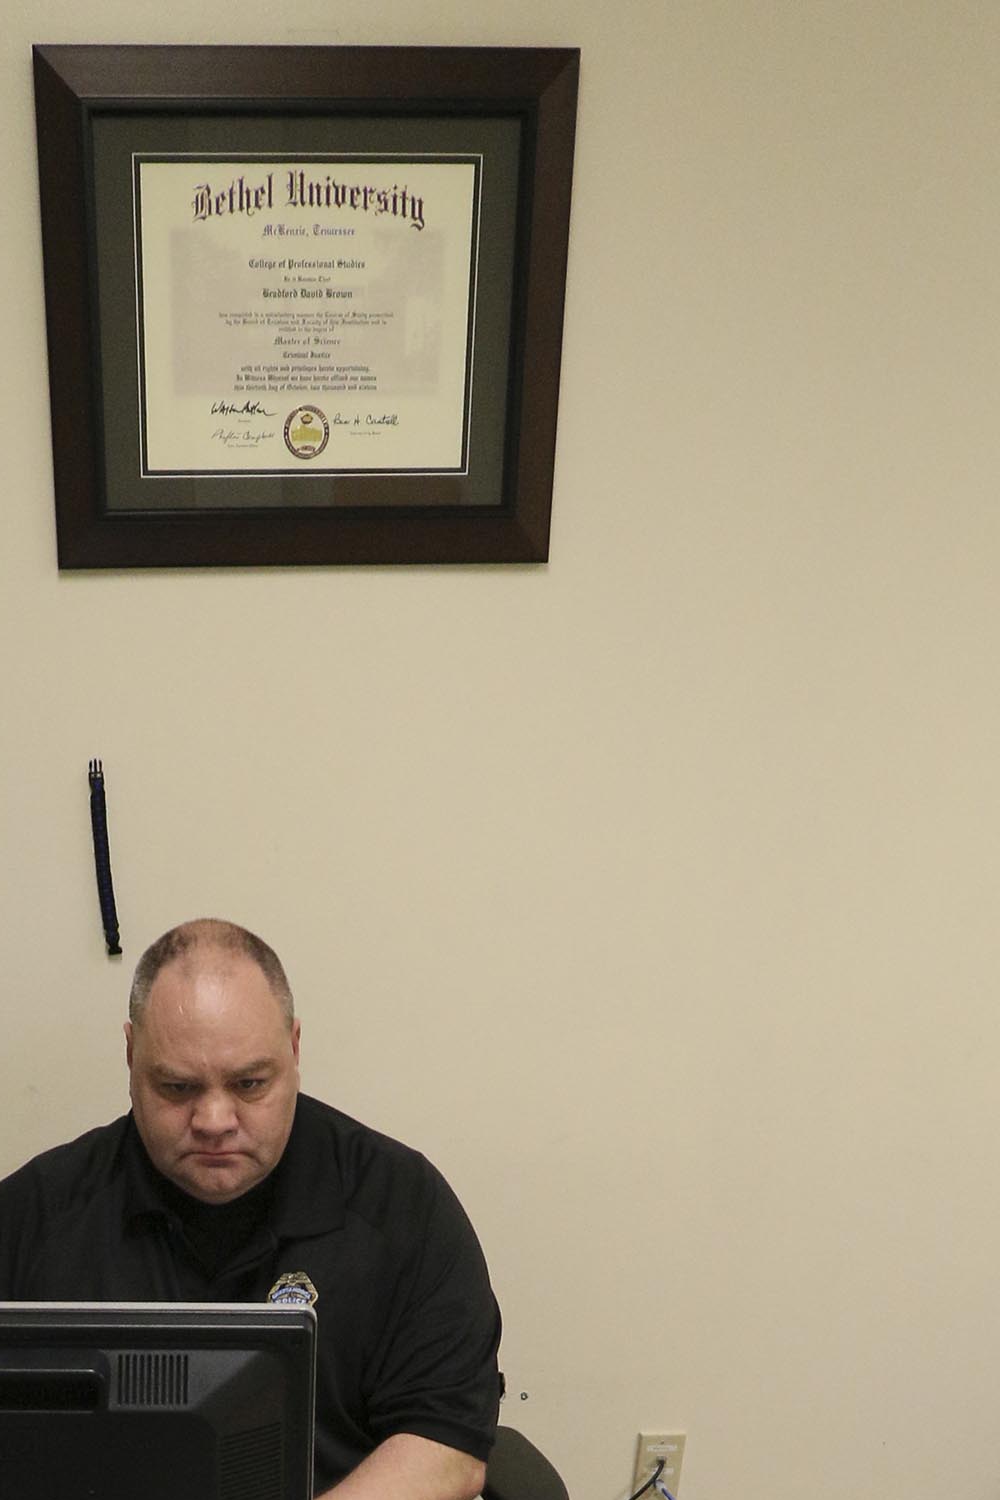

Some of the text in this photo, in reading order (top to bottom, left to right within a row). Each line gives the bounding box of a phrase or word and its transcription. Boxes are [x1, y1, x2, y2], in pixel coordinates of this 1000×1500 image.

[191, 169, 425, 231] Bethel University
[262, 288, 353, 299] Bradford David Brown
